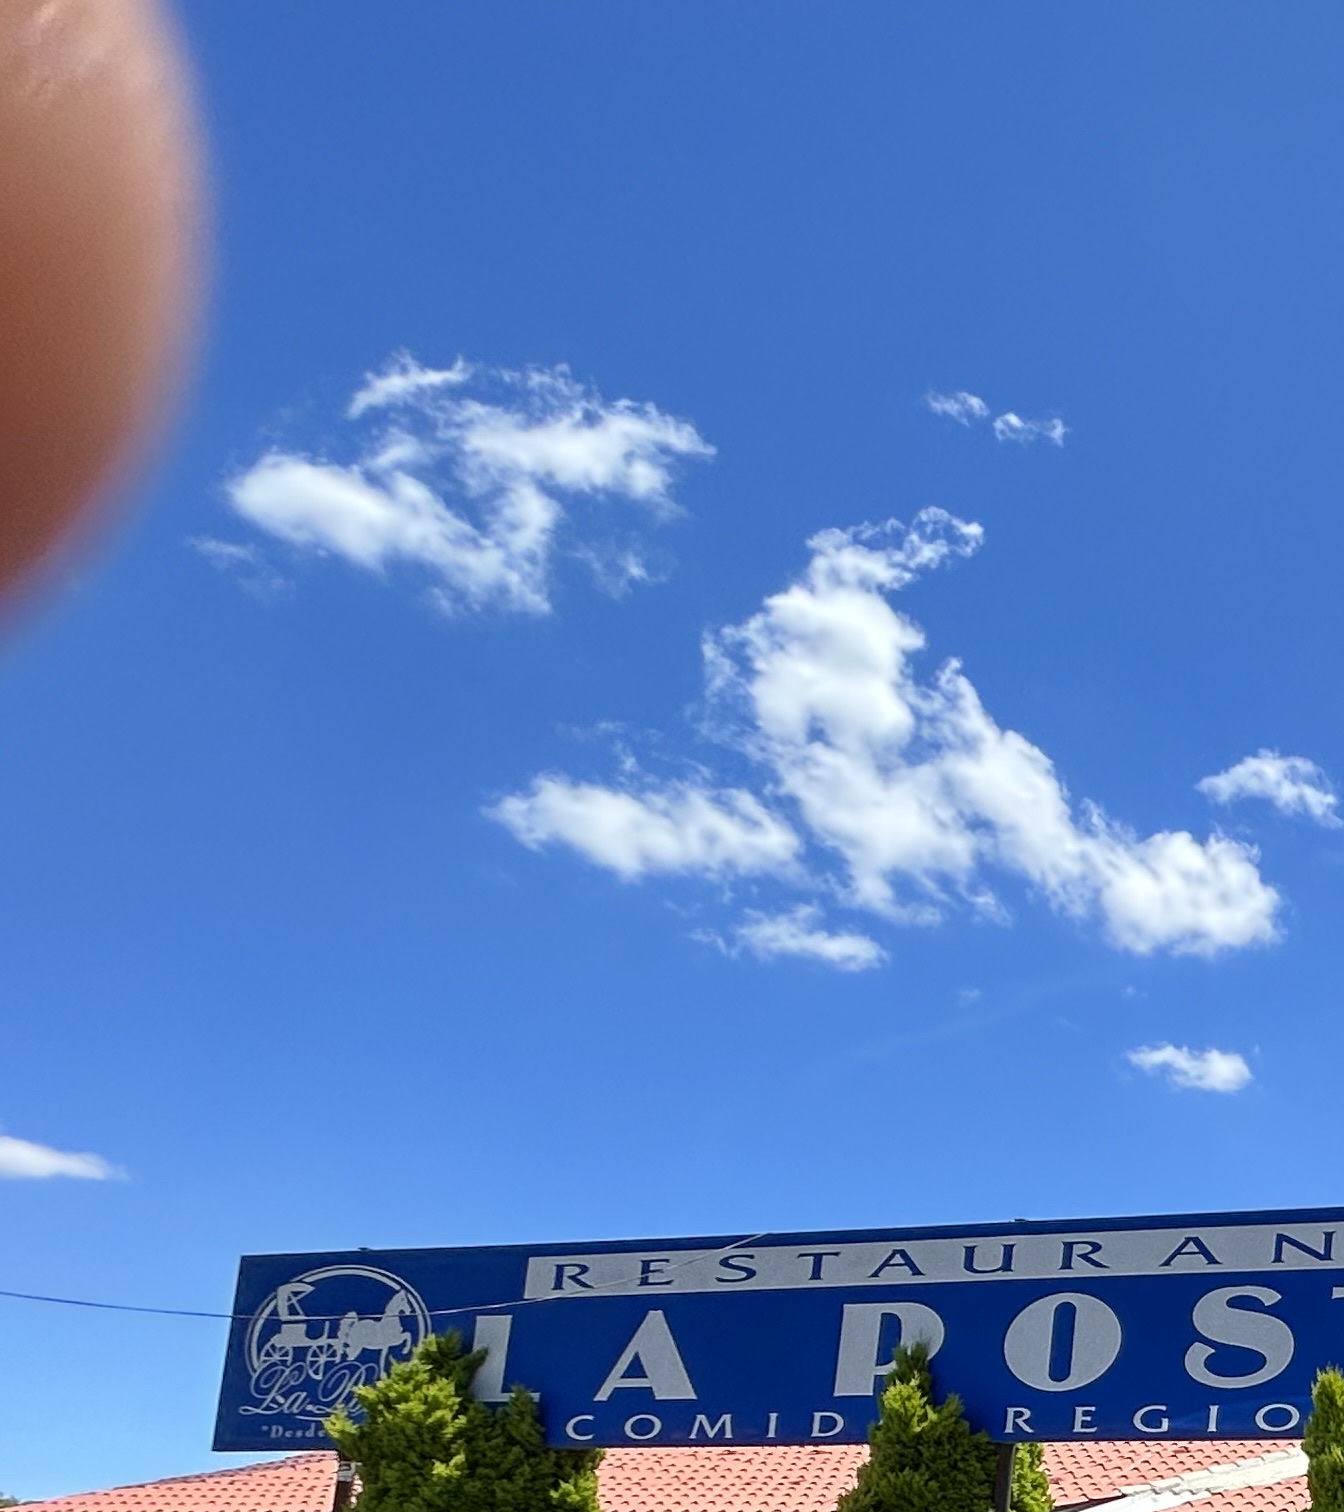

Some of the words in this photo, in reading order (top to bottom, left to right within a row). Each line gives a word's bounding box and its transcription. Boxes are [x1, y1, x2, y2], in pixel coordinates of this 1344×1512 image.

[468, 1309, 698, 1402] LA
[238, 1360, 309, 1415] La
[565, 1411, 884, 1441] COMID
